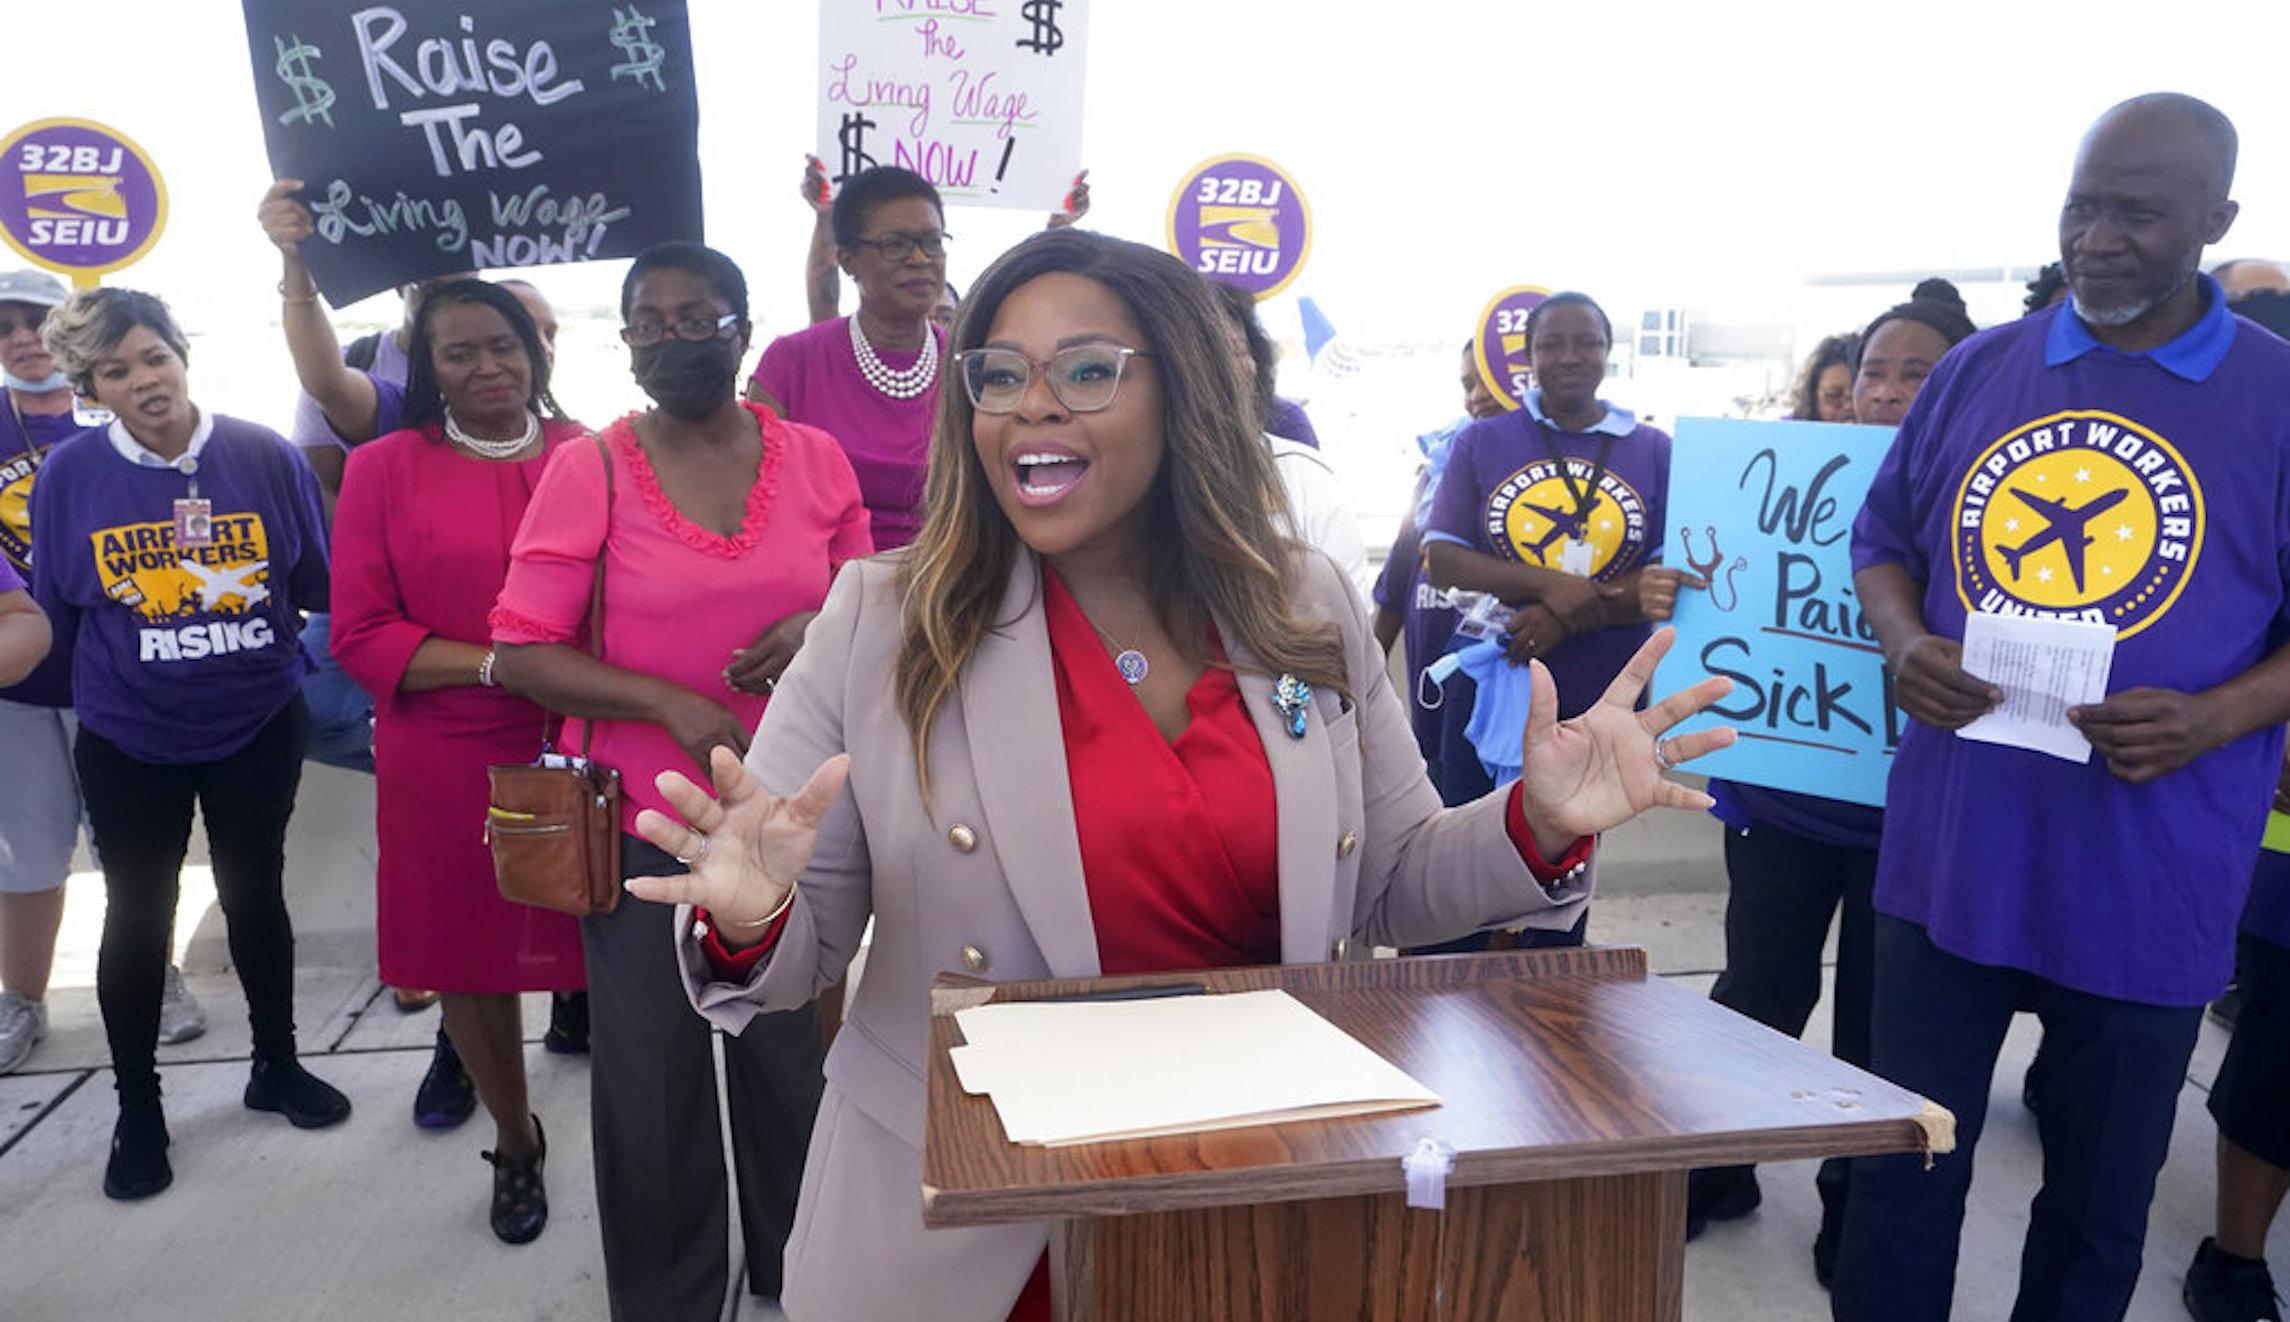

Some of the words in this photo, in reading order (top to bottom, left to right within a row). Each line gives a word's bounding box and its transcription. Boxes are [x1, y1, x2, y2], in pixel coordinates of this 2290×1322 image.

[351, 6, 586, 110] Raise
[915, 17, 965, 60] The
[949, 69, 1038, 139] Wage
[18, 144, 124, 174] 32BJ
[400, 102, 542, 177] The
[311, 179, 468, 250] Living
[490, 185, 631, 228] Wage
[1196, 178, 1281, 207] 32BJ
[28, 218, 130, 247] SEIU
[470, 225, 608, 270] NOW!
[1197, 249, 1279, 277] SEIU
[1497, 309, 1533, 333] 32
[1739, 448, 1851, 546] We
[1961, 422, 2075, 528] AIRPORT
[2087, 421, 2192, 562] WORKERS
[102, 517, 254, 557] AIRPRT
[139, 617, 275, 662] RISING
[1699, 636, 1873, 736] Sick
